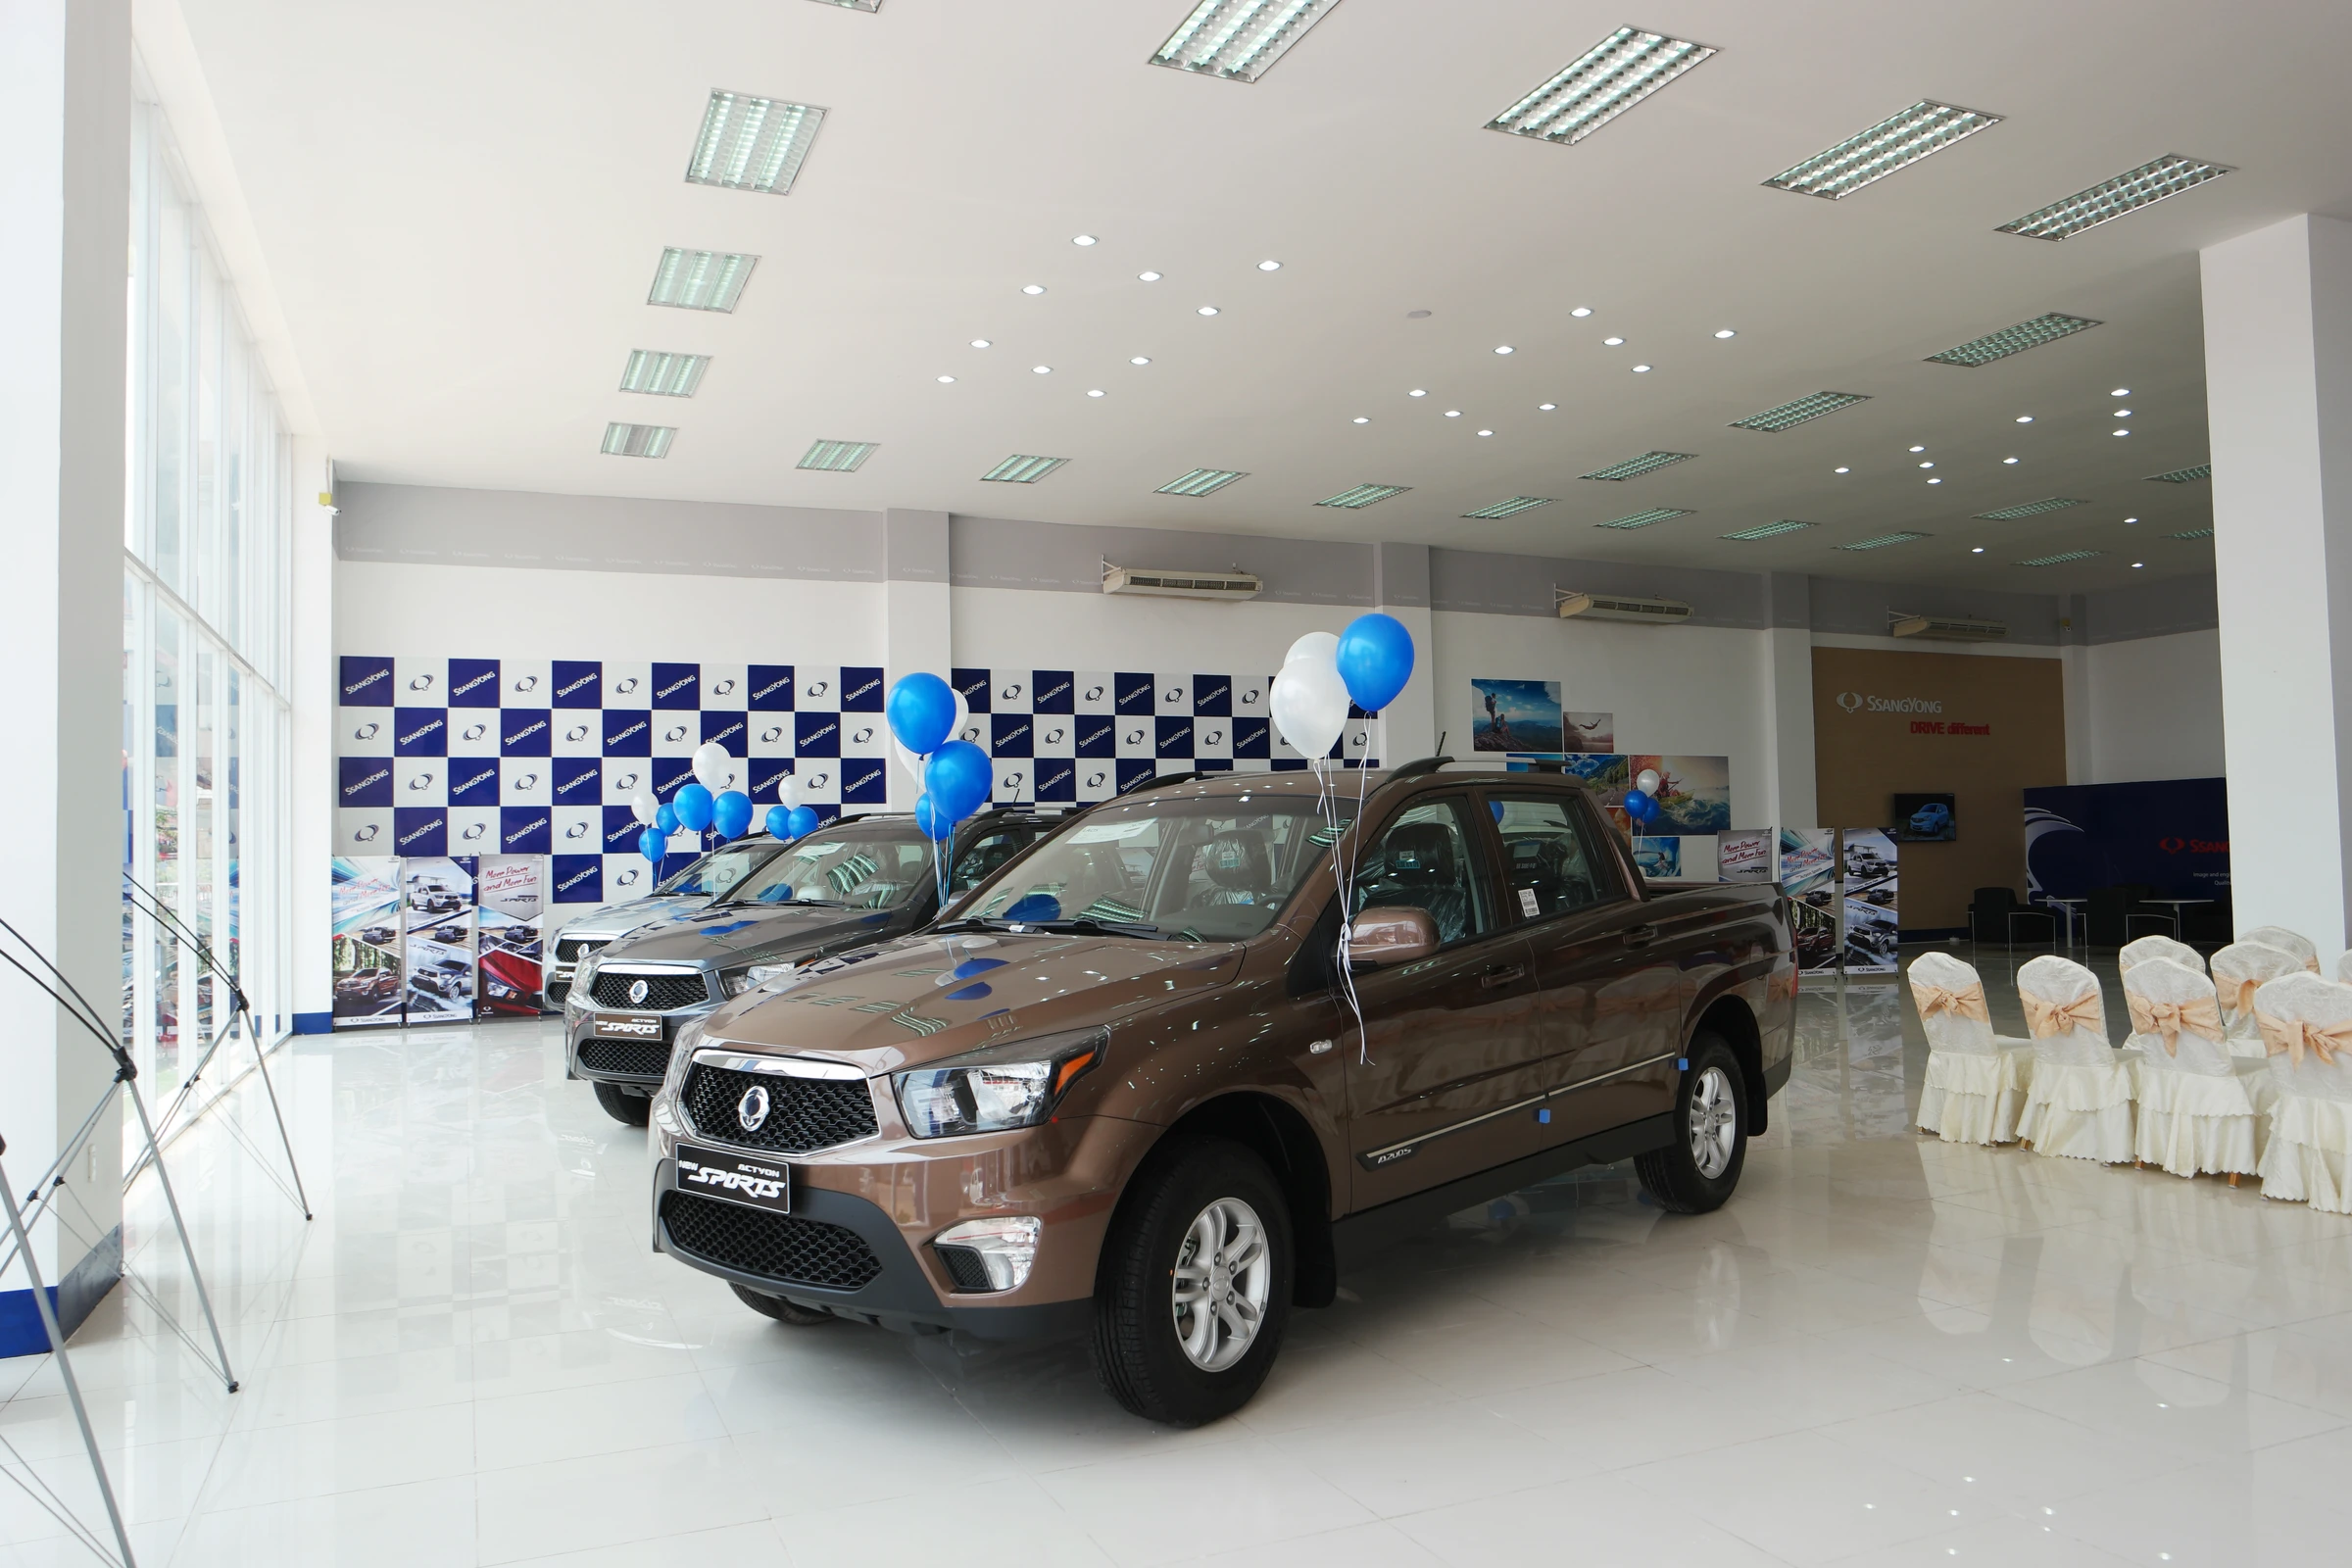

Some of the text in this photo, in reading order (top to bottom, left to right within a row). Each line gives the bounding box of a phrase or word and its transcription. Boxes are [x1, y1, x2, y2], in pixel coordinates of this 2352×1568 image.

[346, 669, 390, 694] SSANGYONG
[454, 671, 496, 696] SSANGYONG
[557, 673, 598, 697] SSANGYONG
[657, 675, 696, 699] SSANGYONG
[753, 677, 791, 700] SSANGYONG
[846, 679, 881, 701] SSANGYONG
[962, 680, 987, 697] NGYONG
[1038, 682, 1070, 704] SSANGYONG
[1119, 684, 1152, 705] SSANGYONG
[1198, 686, 1228, 707] SSANGYONG
[1867, 695, 1942, 713] SSANGYONG
[400, 720, 444, 745] SSANGYONG
[505, 721, 547, 745] SSANGYONG
[608, 721, 647, 745] SSANGYONG
[800, 723, 837, 747] SSANGYONG
[996, 725, 1029, 747] SSANGYONG
[1079, 726, 1112, 747] SSANGYONG
[1159, 727, 1191, 748] SSANGYONG
[1237, 728, 1267, 749] SSANGYONG
[1910, 721, 1990, 735] DRIVE different
[345, 769, 389, 795] SSANGYONG
[453, 769, 496, 795] SSANGYONG
[558, 769, 598, 794] SSANGYONG
[752, 769, 790, 794] SSANGYONG
[846, 769, 882, 793] SSANGYONG
[1039, 769, 1072, 791] SSANGYONG
[1120, 769, 1152, 792] SSANGYONG
[400, 819, 443, 845] SSANGYONG
[506, 818, 548, 844] SSANGYONG
[607, 821, 642, 843] SSANGYON
[2188, 839, 2230, 854] SSAN
[483, 875, 537, 891] and More Fun
[485, 865, 530, 879] More Power
[558, 866, 599, 891] SSANGYONG
[601, 1022, 660, 1035] SPORTS
[737, 1163, 780, 1178] ACTYON
[687, 1166, 786, 1199] SPORTS
